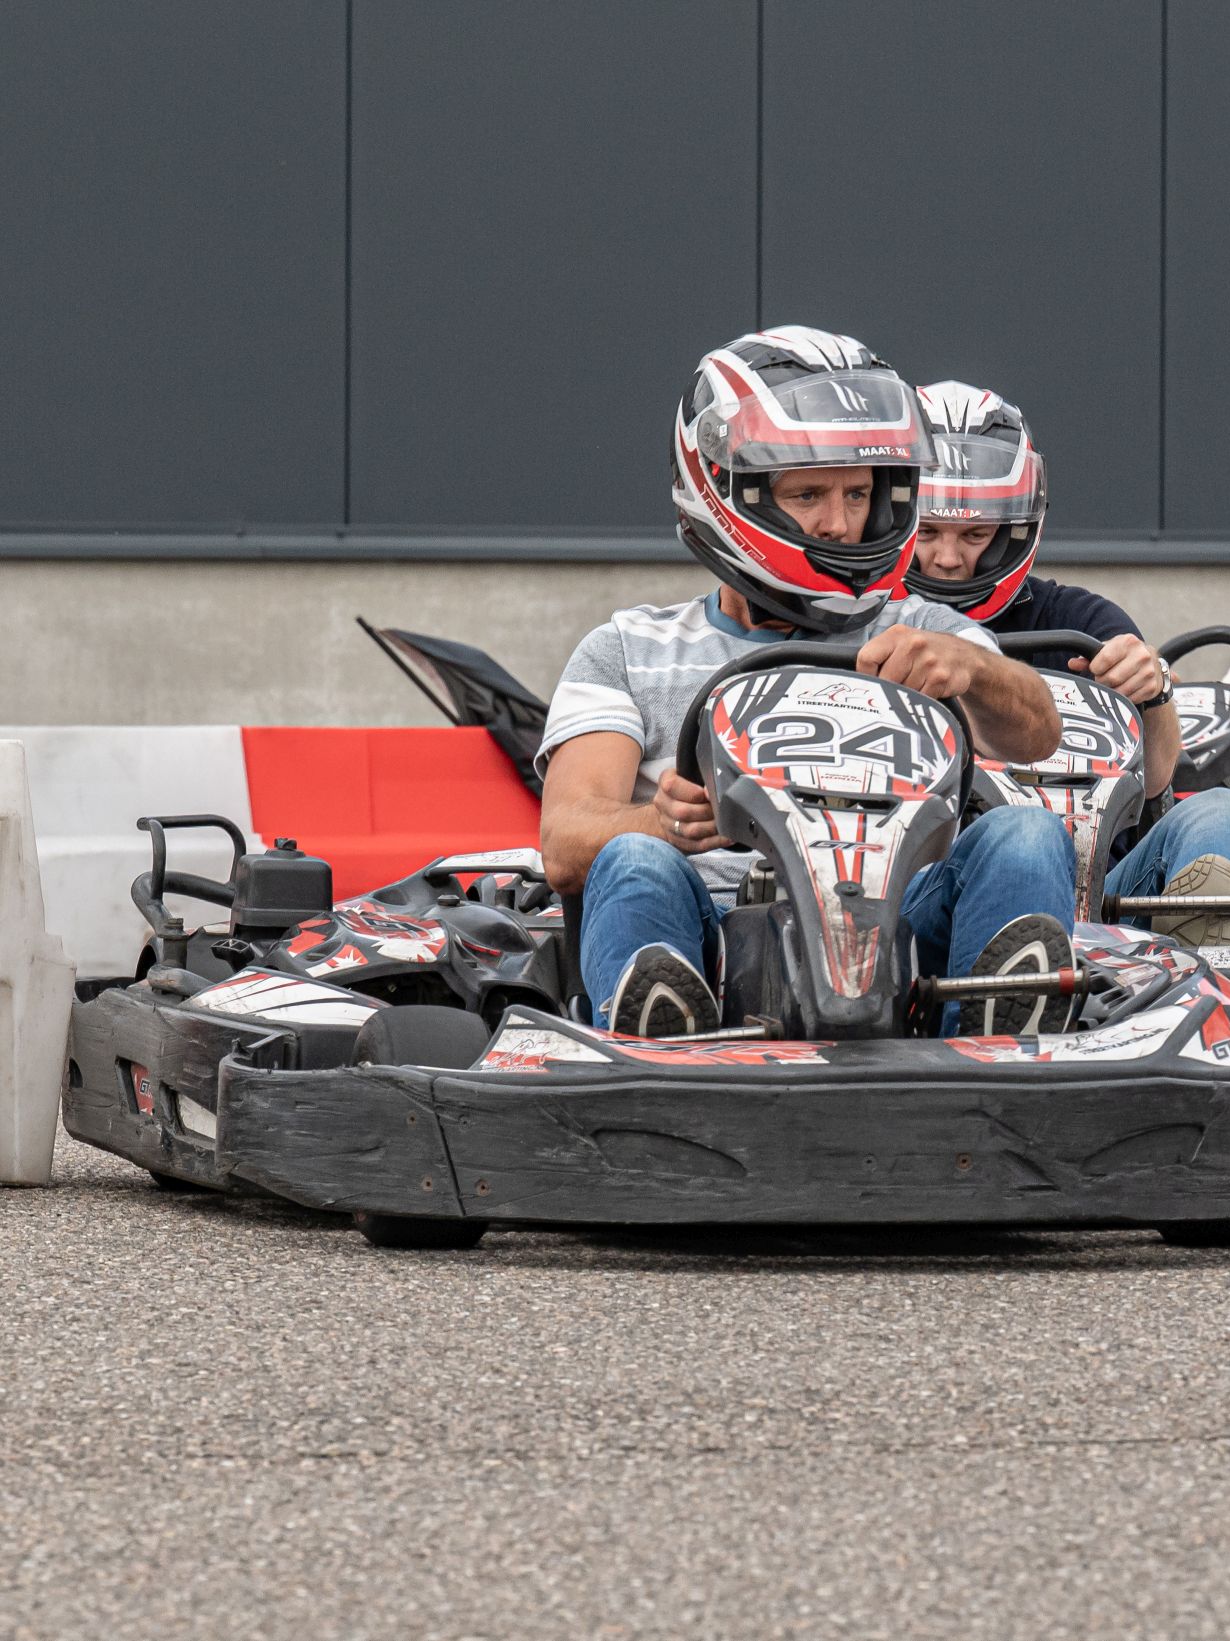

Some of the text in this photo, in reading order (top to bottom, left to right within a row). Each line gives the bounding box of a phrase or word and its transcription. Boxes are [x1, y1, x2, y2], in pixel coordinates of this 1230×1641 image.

[896, 447, 909, 457] XL
[748, 711, 930, 784] 24
[1060, 709, 1118, 762] 5
